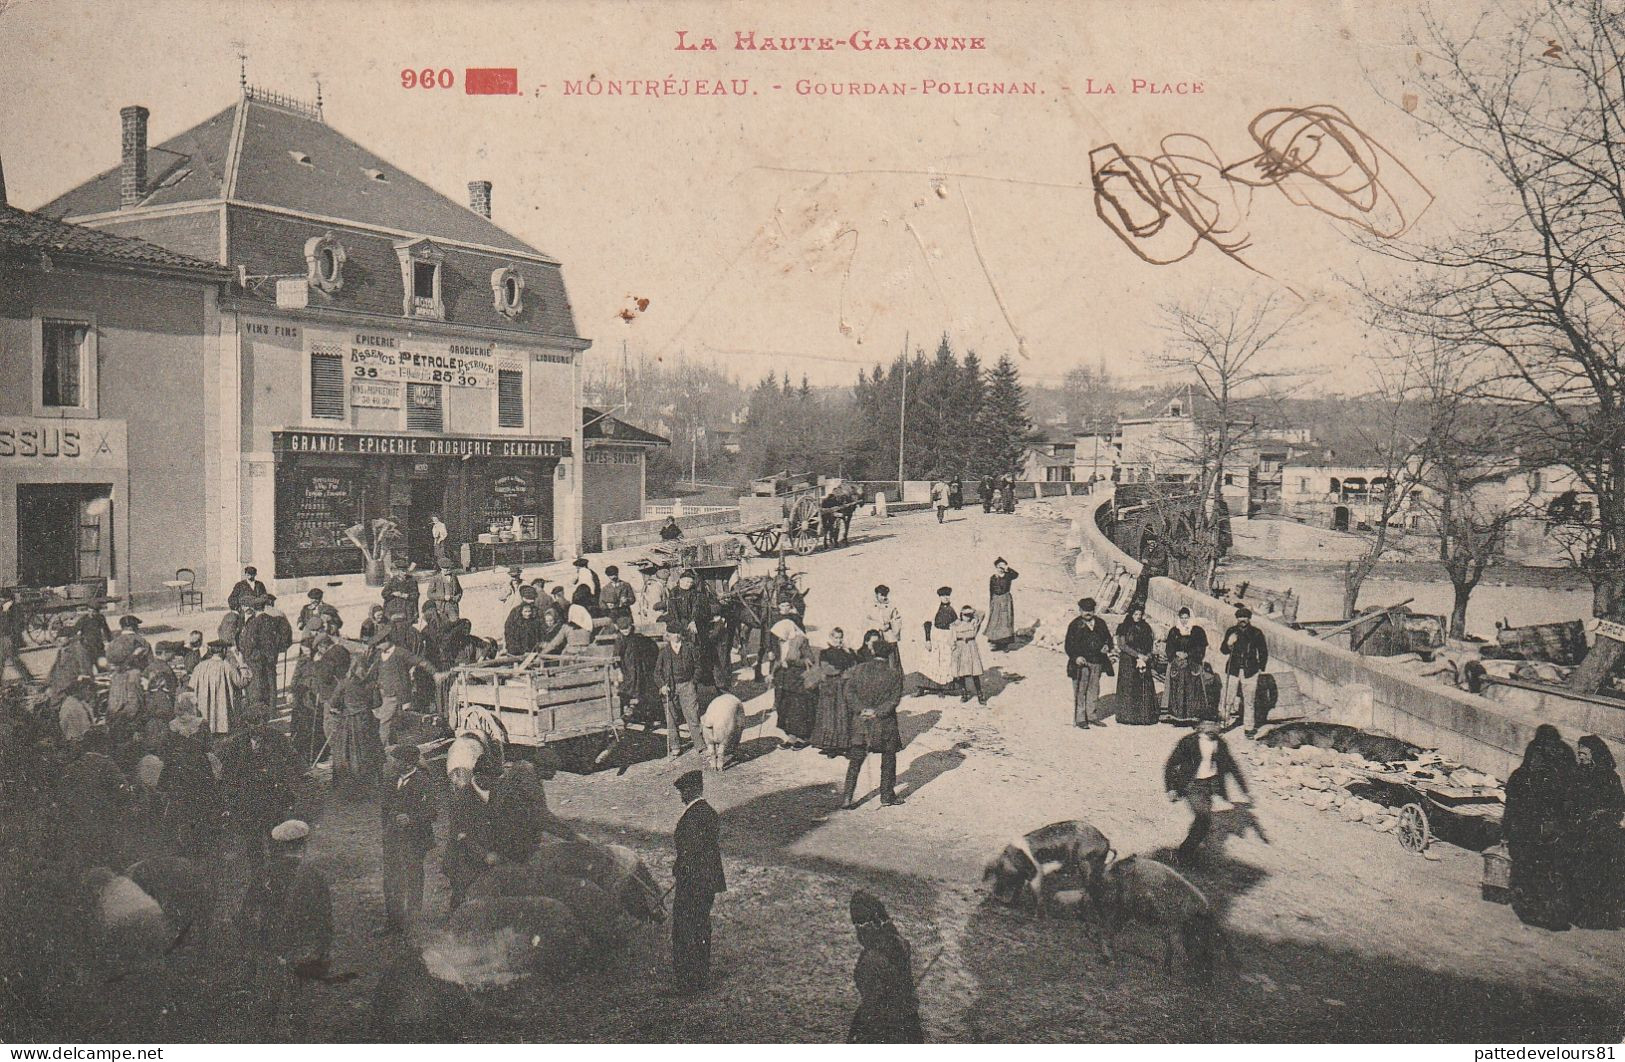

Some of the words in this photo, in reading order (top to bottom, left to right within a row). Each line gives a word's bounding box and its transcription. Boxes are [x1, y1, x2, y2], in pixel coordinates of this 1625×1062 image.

[246, 323, 269, 335] VINS
[275, 326, 297, 337] FINS
[356, 335, 395, 347] EPICERIE
[351, 348, 396, 365] ESSENCE
[450, 344, 492, 357] DROGUERIE
[354, 366, 378, 378] 35
[458, 376, 477, 386] 30
[292, 435, 344, 451] GRANDE
[359, 438, 417, 454] EPICERIE
[430, 440, 492, 455] DROGUERIE
[503, 442, 555, 456] CENTRALE
